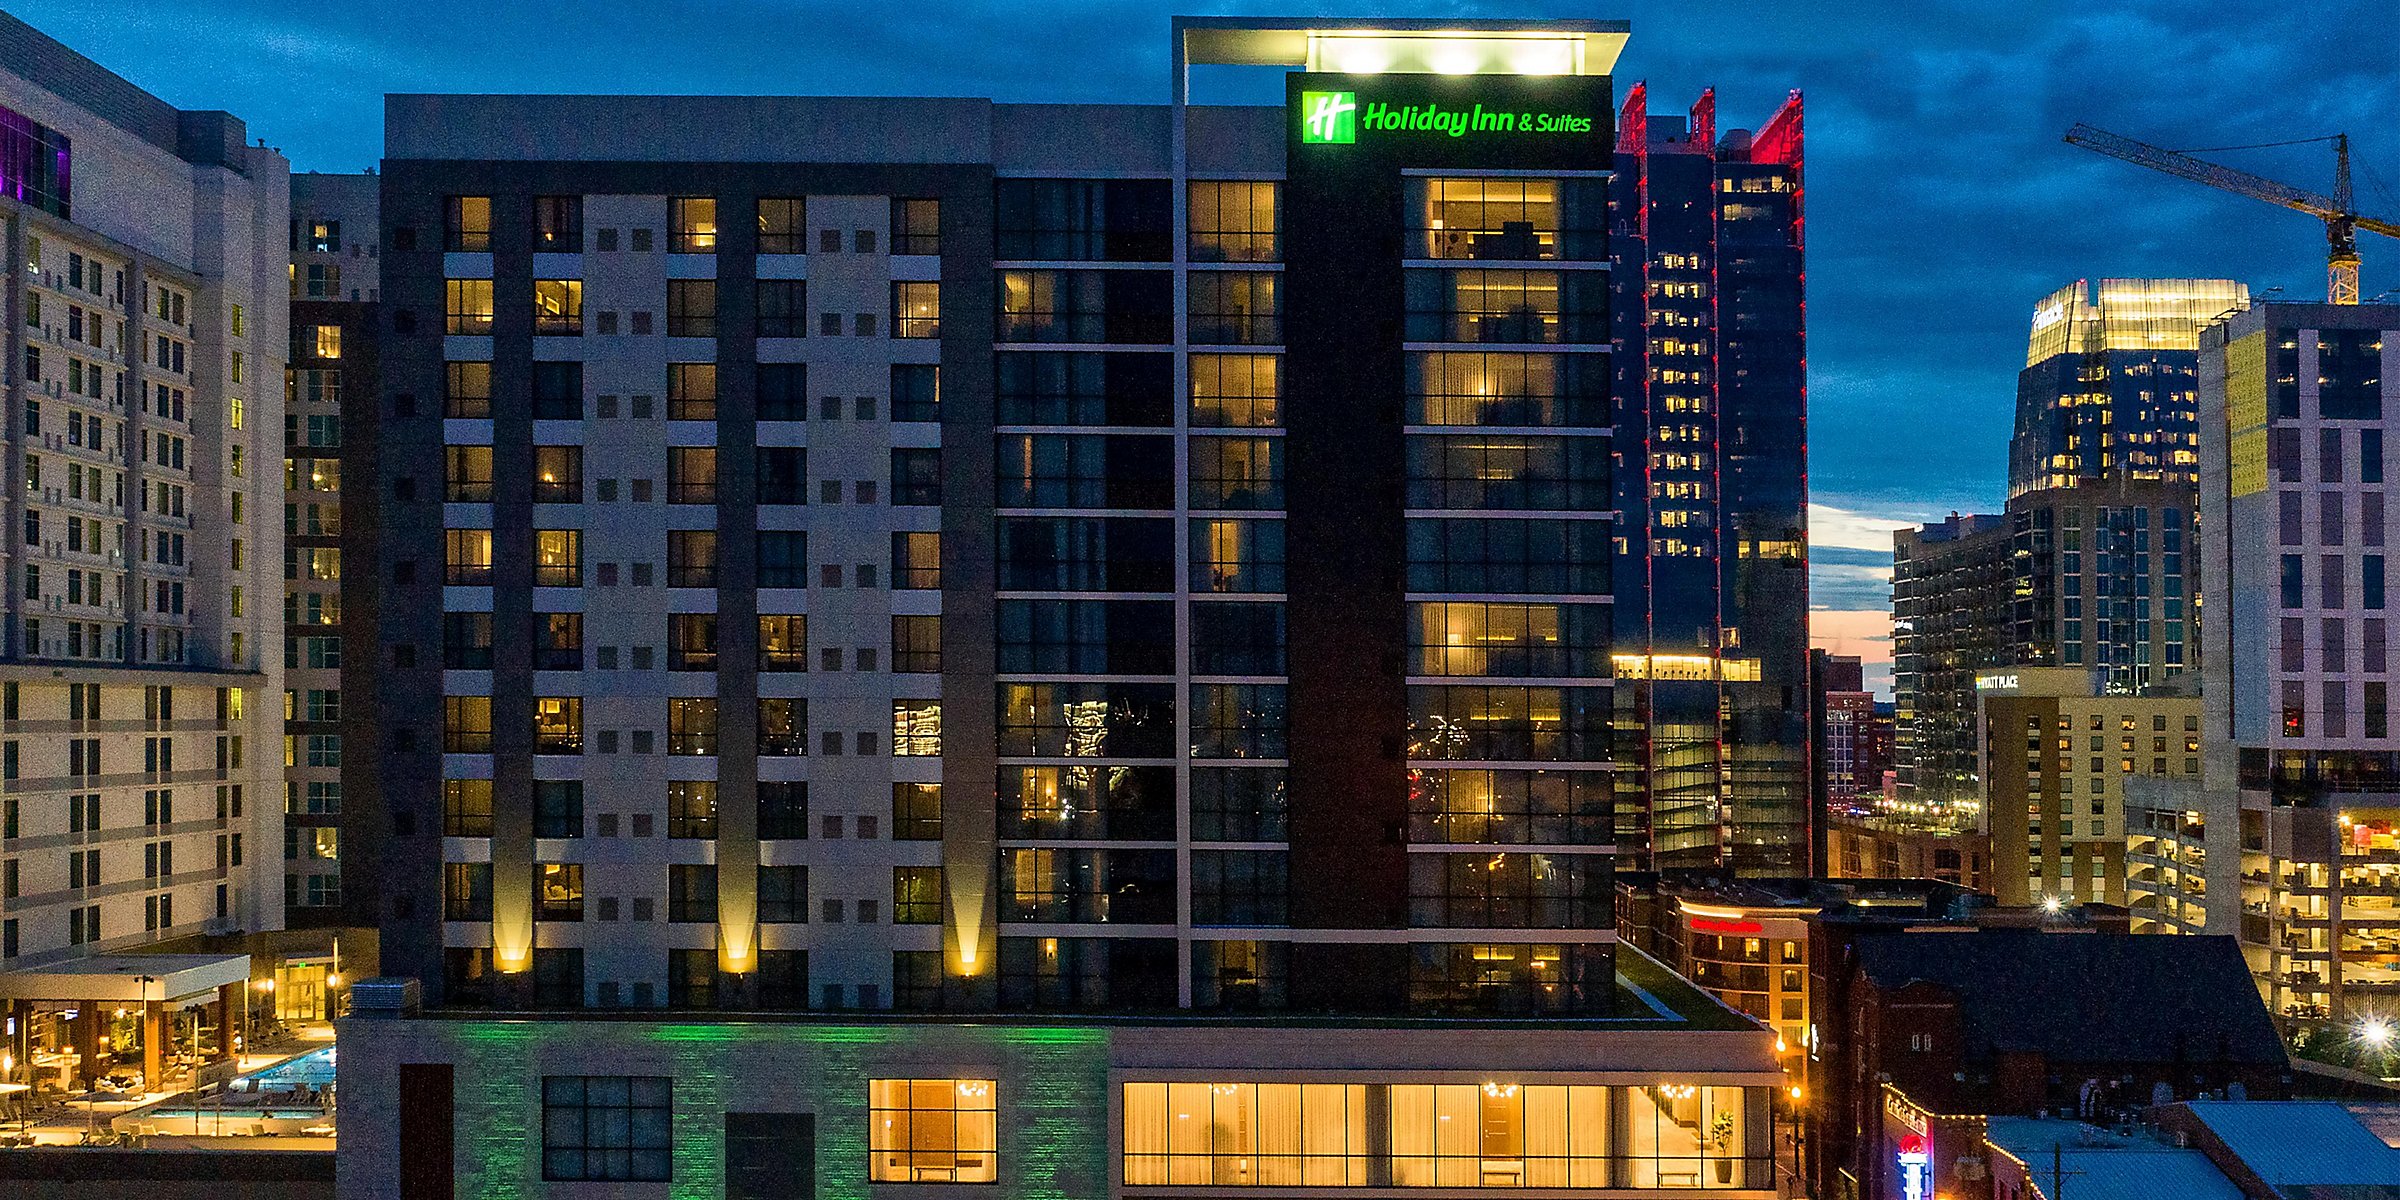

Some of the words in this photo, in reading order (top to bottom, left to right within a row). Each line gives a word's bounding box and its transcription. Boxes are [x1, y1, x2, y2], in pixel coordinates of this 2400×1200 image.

[1363, 102, 1468, 137] Holiday
[1471, 103, 1514, 131] Inn
[1518, 112, 1533, 131] &
[1535, 113, 1591, 132] Suites
[1999, 675, 2018, 688] PLACE
